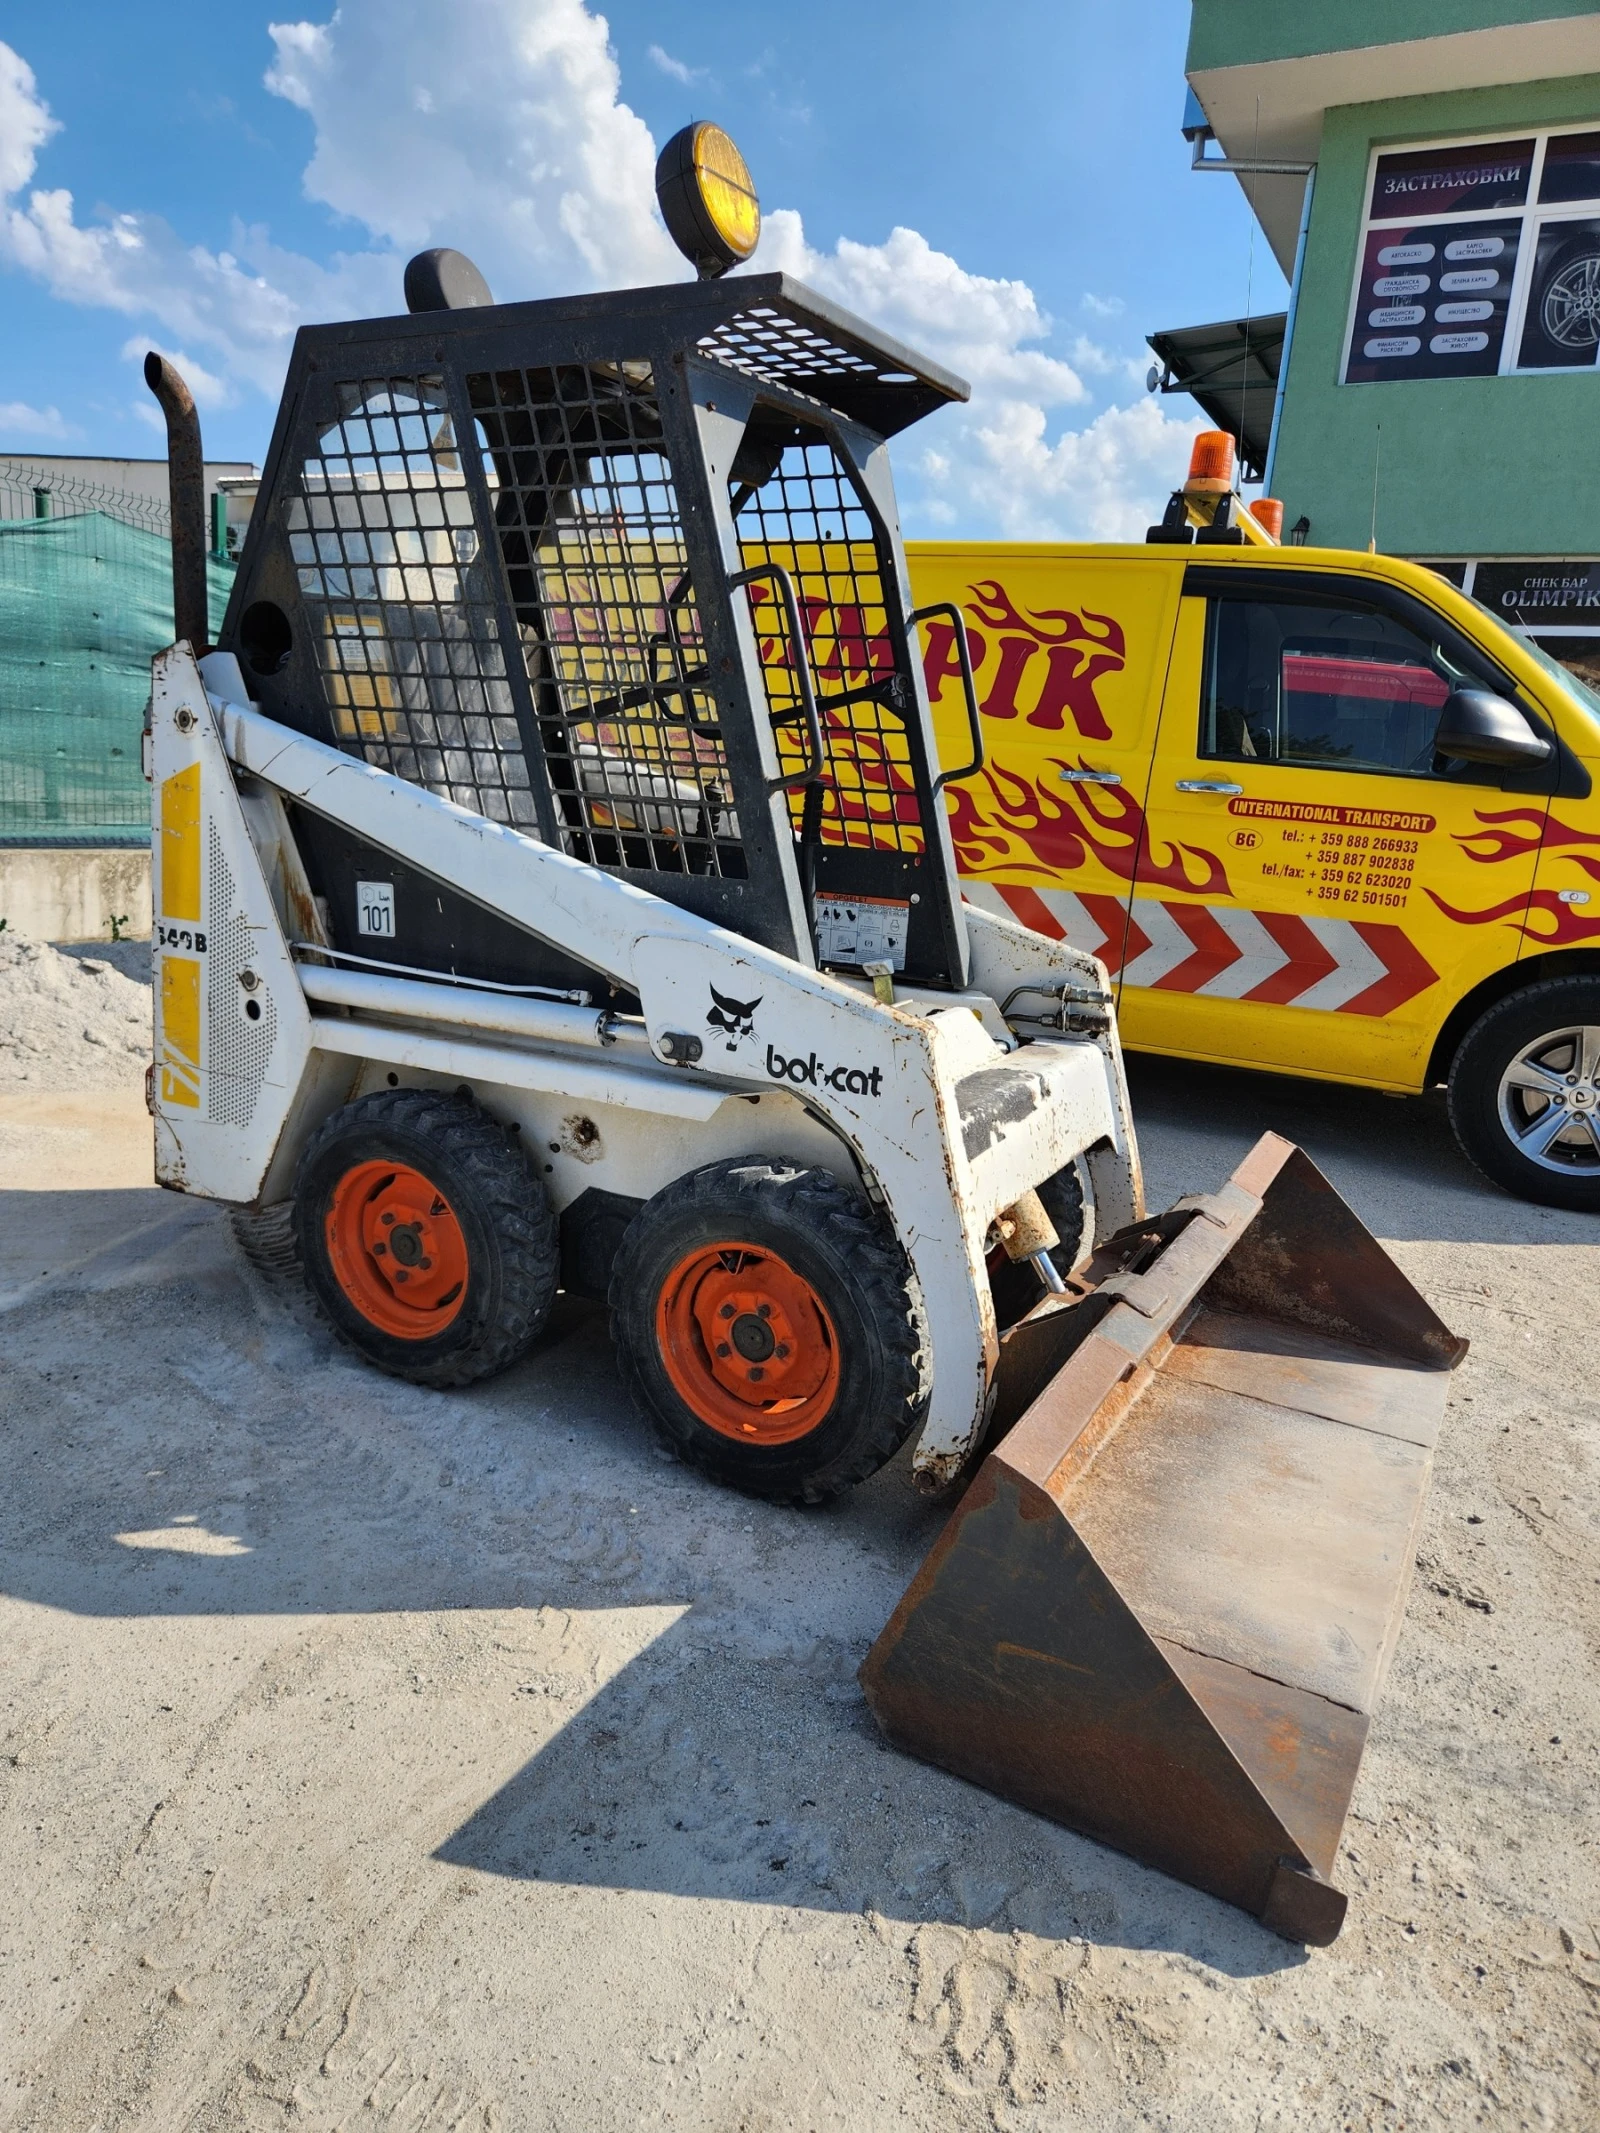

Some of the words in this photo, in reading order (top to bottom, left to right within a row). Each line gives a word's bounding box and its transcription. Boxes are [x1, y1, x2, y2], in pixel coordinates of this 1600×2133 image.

[1385, 165, 1522, 194] ЗАСТРАХОВКИ
[1523, 577, 1560, 589] СНЕК
[1561, 577, 1588, 589] БАР
[1501, 589, 1600, 607] OLIMPIK
[1233, 800, 1340, 822] INTERNATIONAL
[1344, 809, 1430, 831] TRANSPORT
[1235, 832, 1256, 847] BG
[1282, 829, 1305, 843] tel.:
[1309, 834, 1316, 843] +
[1320, 832, 1344, 846] 359
[1346, 835, 1369, 849] 888
[1372, 837, 1419, 854] 266933
[1305, 851, 1313, 860] +
[1317, 850, 1340, 864] 359
[1343, 852, 1366, 866] 887
[1368, 855, 1415, 872] 902838
[1262, 863, 1305, 879] tel./fax:
[1309, 870, 1317, 879] +
[1321, 868, 1344, 882] 359
[1347, 871, 1362, 885] 62
[1365, 873, 1412, 890] 623020
[832, 894, 868, 903] OPGELET
[1305, 888, 1313, 897] +
[1318, 886, 1340, 900] 359
[1343, 889, 1359, 903] 62
[1362, 891, 1408, 908] 501501
[362, 905, 390, 933] 101
